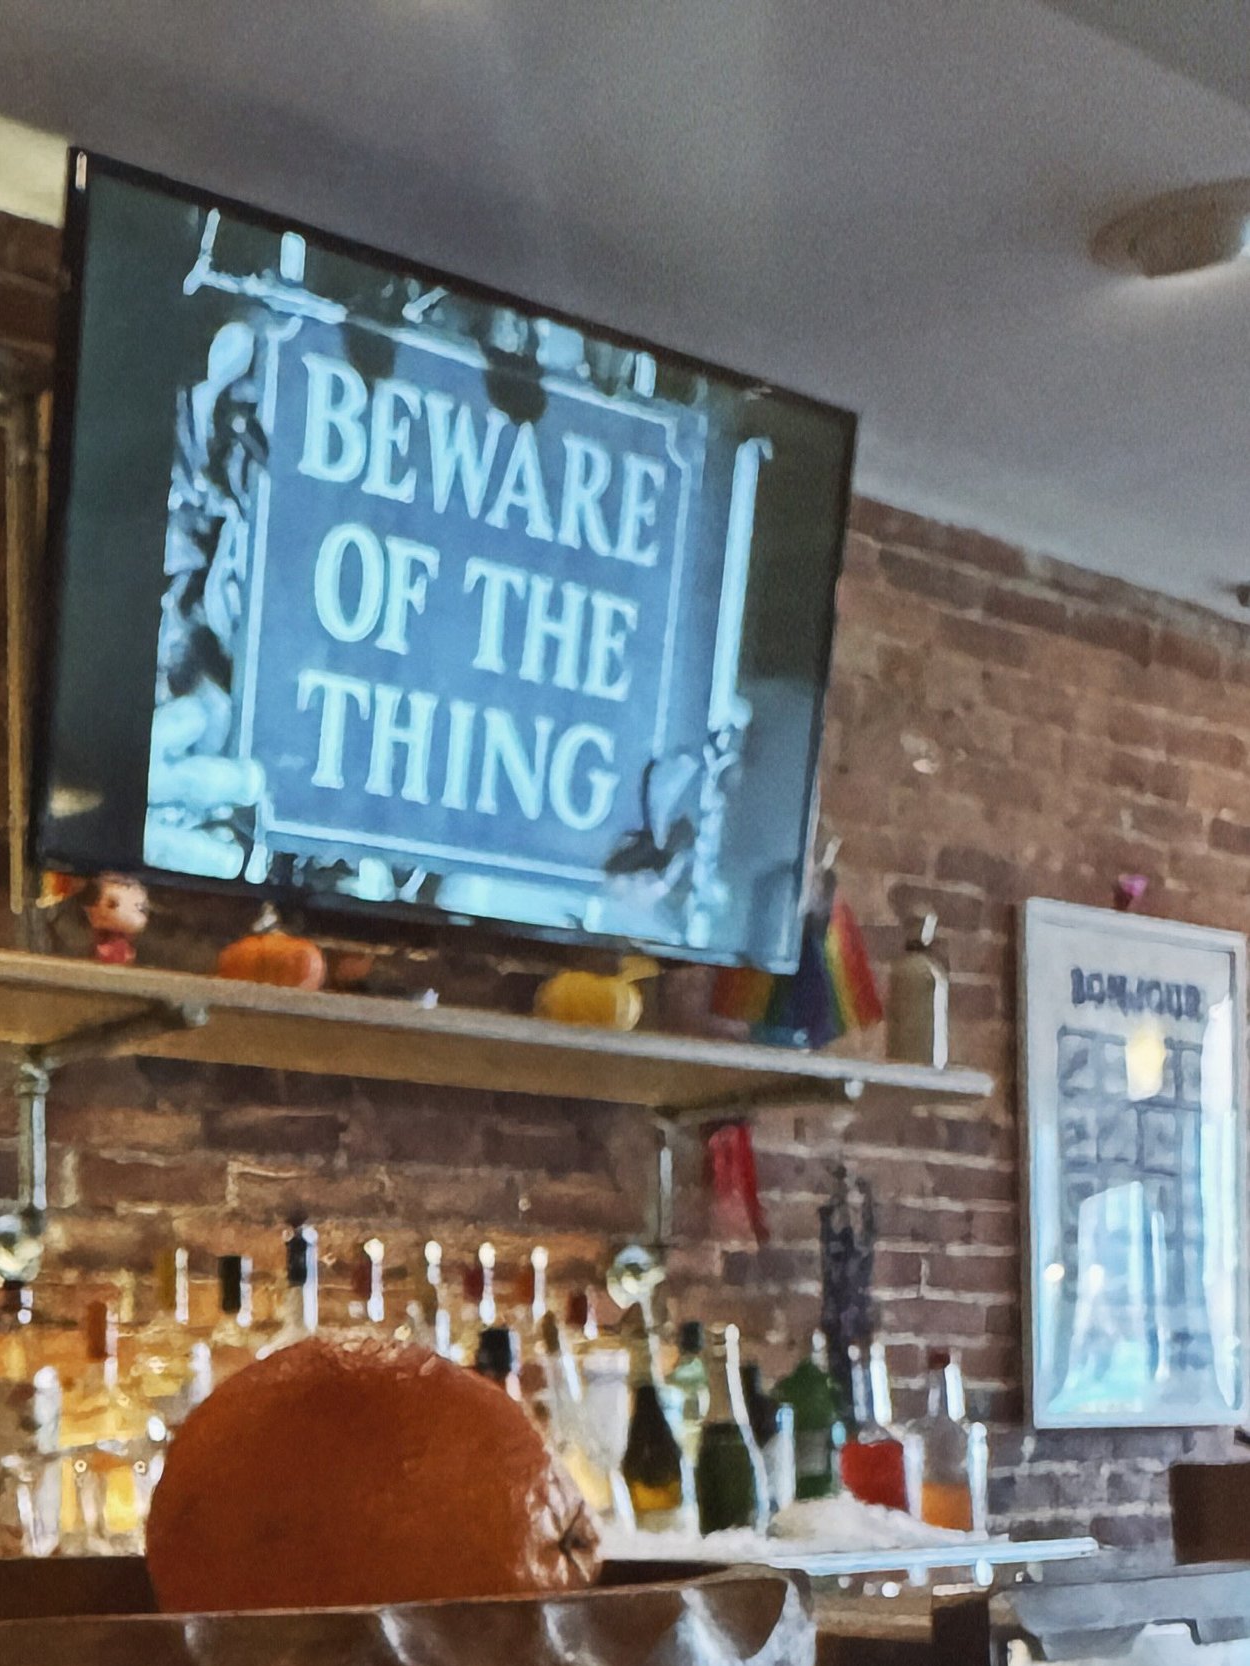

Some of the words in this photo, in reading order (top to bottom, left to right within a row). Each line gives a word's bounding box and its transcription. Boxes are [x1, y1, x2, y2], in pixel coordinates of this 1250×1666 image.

[299, 354, 665, 567] BEWARE
[314, 524, 440, 655] OF
[465, 557, 637, 700] THE
[298, 670, 618, 831] THING
